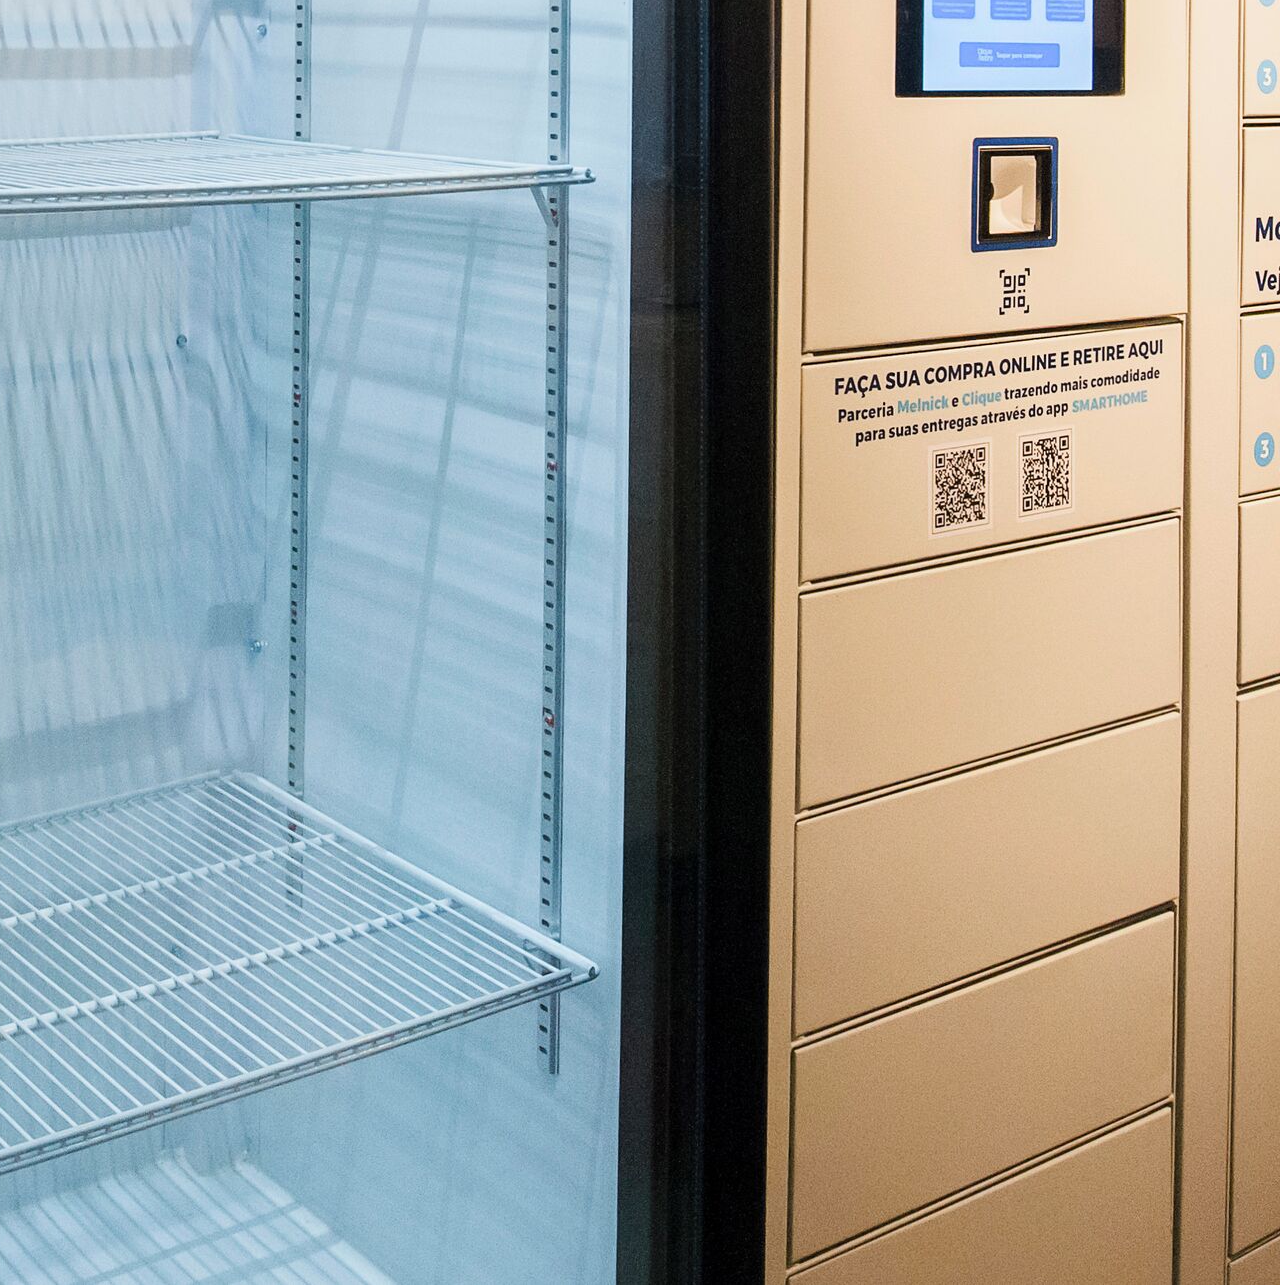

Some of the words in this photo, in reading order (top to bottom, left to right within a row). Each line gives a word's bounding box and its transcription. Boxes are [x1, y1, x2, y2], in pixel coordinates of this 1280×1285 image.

[1263, 67, 1272, 87] 3
[834, 373, 882, 398] FAÇA
[885, 370, 920, 390] SUA
[924, 362, 996, 385] COMPRA
[999, 352, 1057, 375] ONLINE
[1060, 351, 1070, 367] E
[1073, 344, 1125, 366] RETIRE
[1128, 339, 1164, 361] AQUI
[1261, 352, 1267, 371] 1
[837, 401, 894, 423] Parceria
[897, 395, 949, 414] Melnick
[951, 396, 959, 407] e
[962, 389, 1002, 409] Clique
[1004, 381, 1058, 401] trazendo
[1060, 378, 1088, 393] mais
[1090, 367, 1161, 389] comodidade
[855, 427, 886, 447] para
[888, 423, 919, 440] suas
[921, 414, 979, 437] entregas
[980, 405, 1026, 425] através
[1028, 404, 1044, 418] do
[1046, 401, 1069, 420] app
[1072, 390, 1149, 414] SMARTHOME
[1260, 439, 1270, 459] 3
